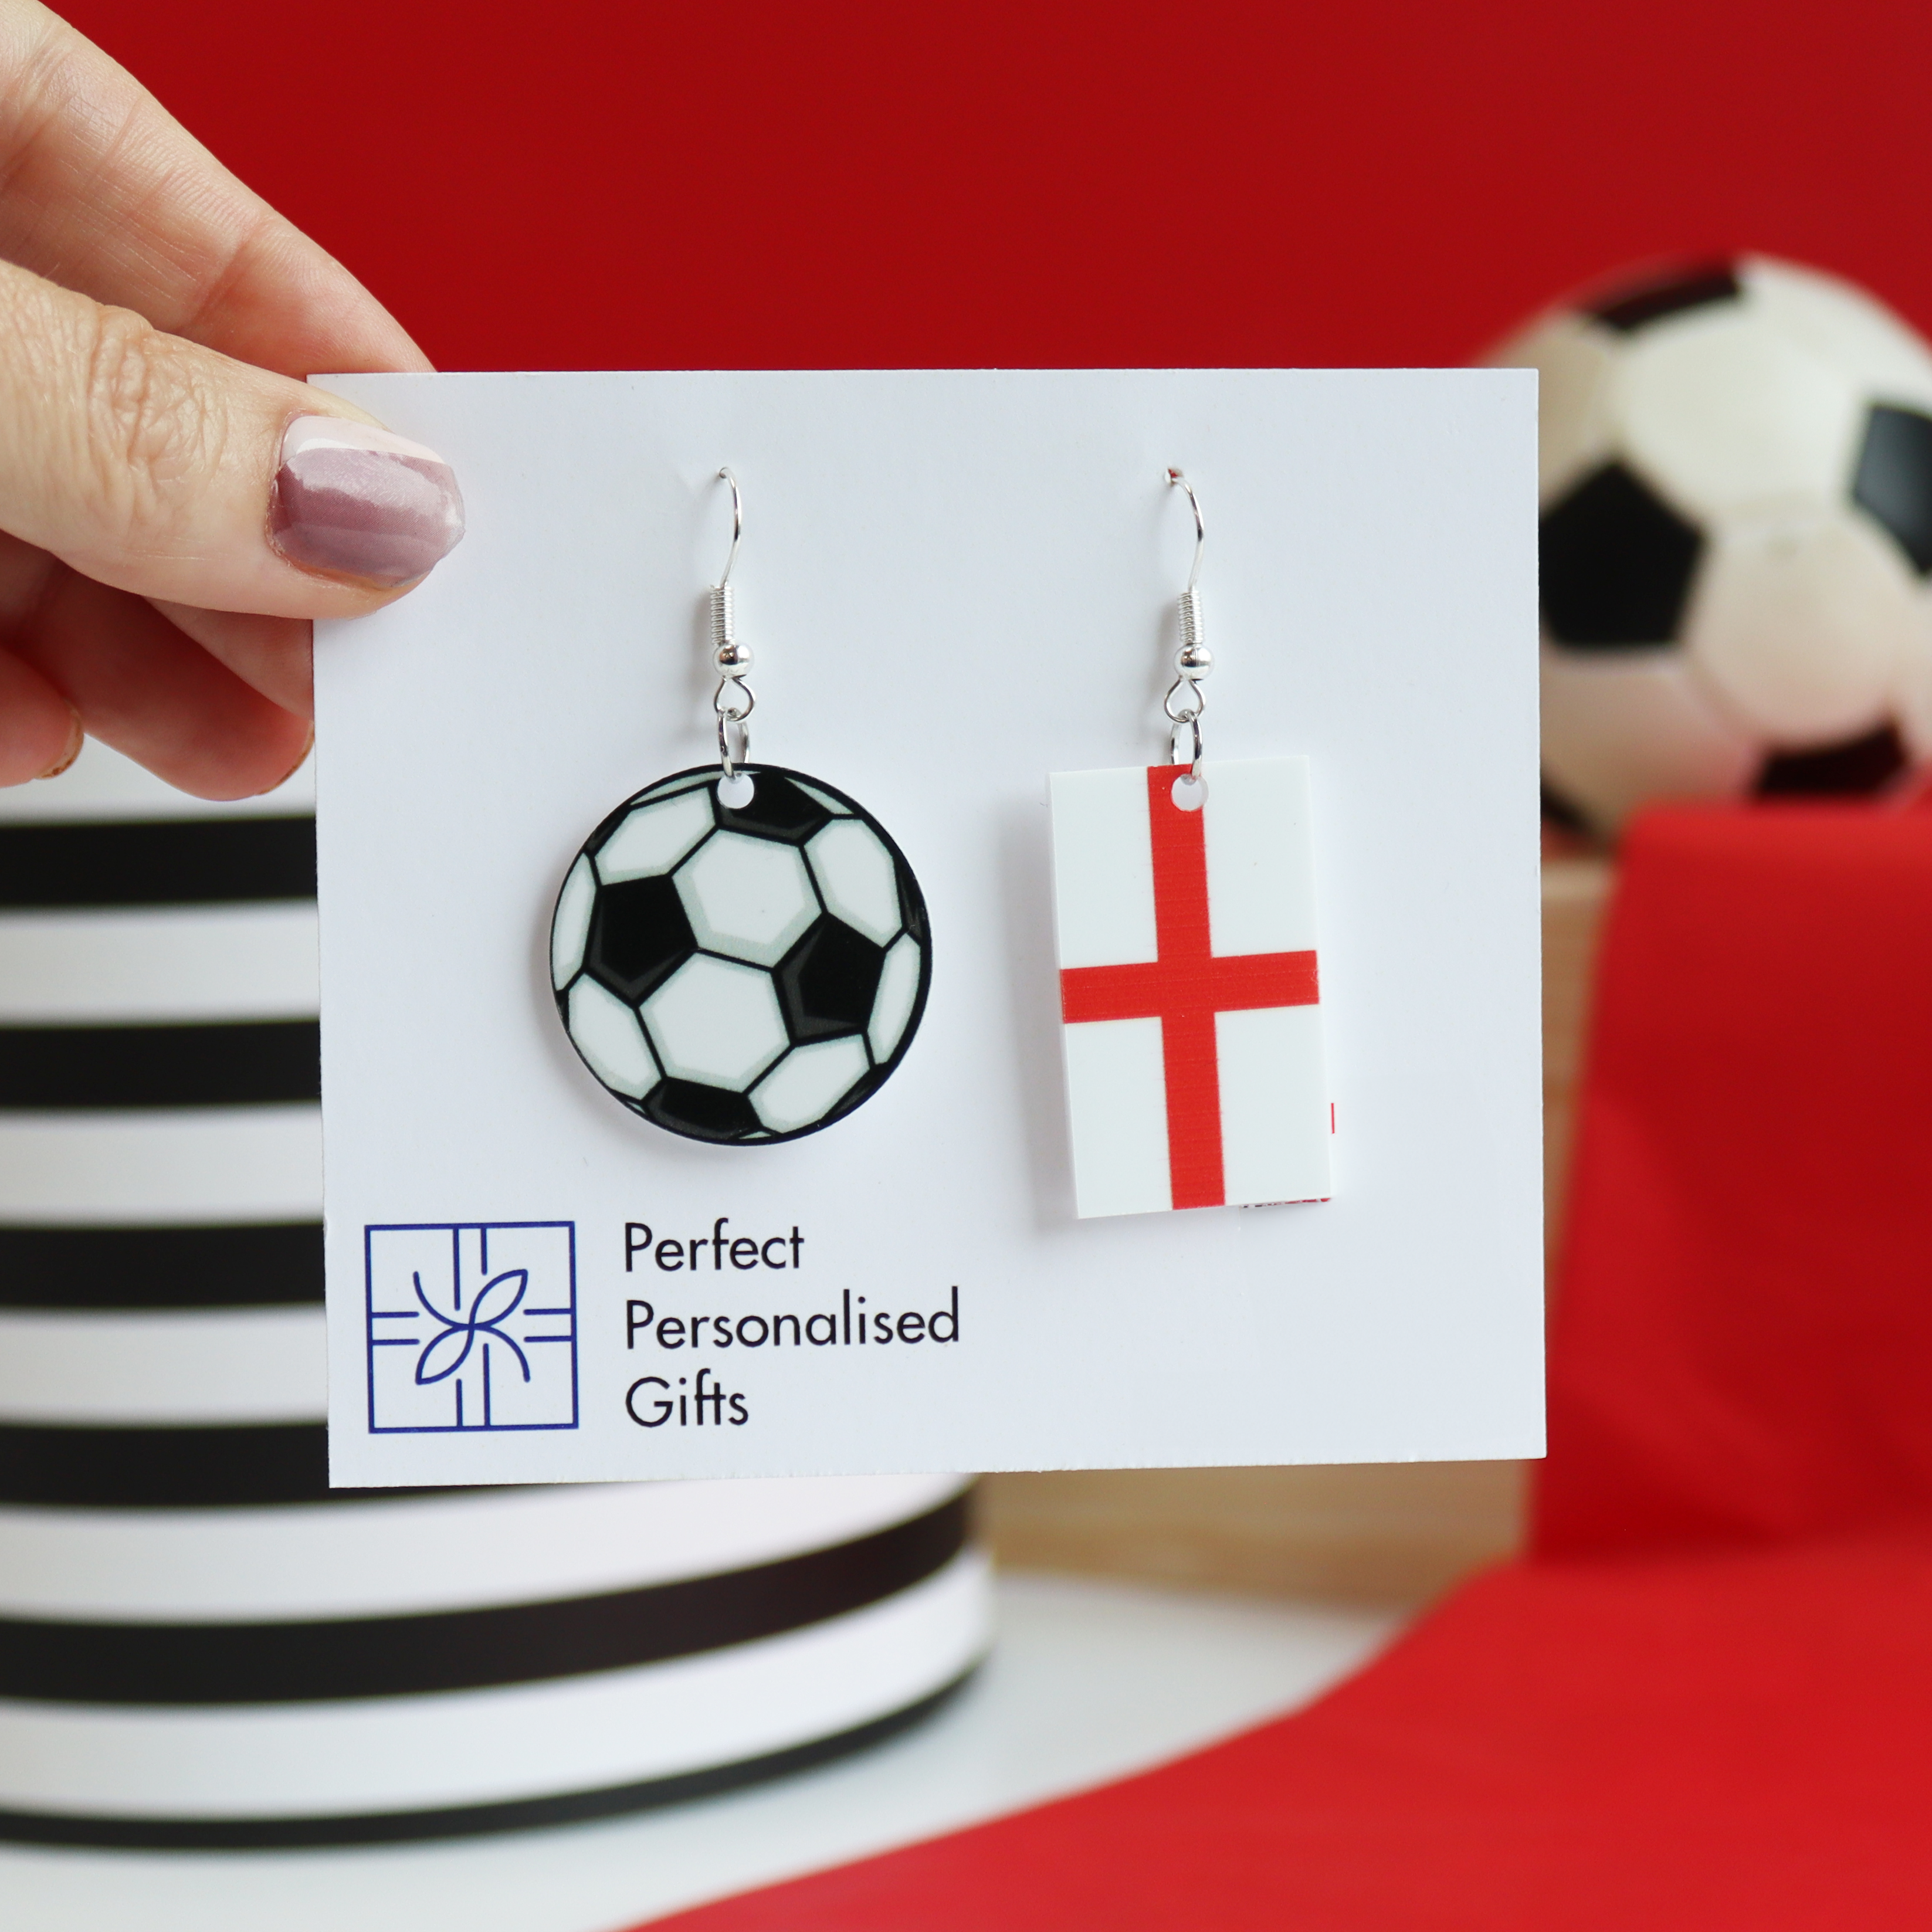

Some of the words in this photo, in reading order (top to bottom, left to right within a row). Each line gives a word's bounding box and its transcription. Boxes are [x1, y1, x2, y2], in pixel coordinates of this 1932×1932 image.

[625, 1217, 805, 1272] Perfect
[626, 1286, 959, 1350] Personalised
[625, 1368, 749, 1428] Gifts
